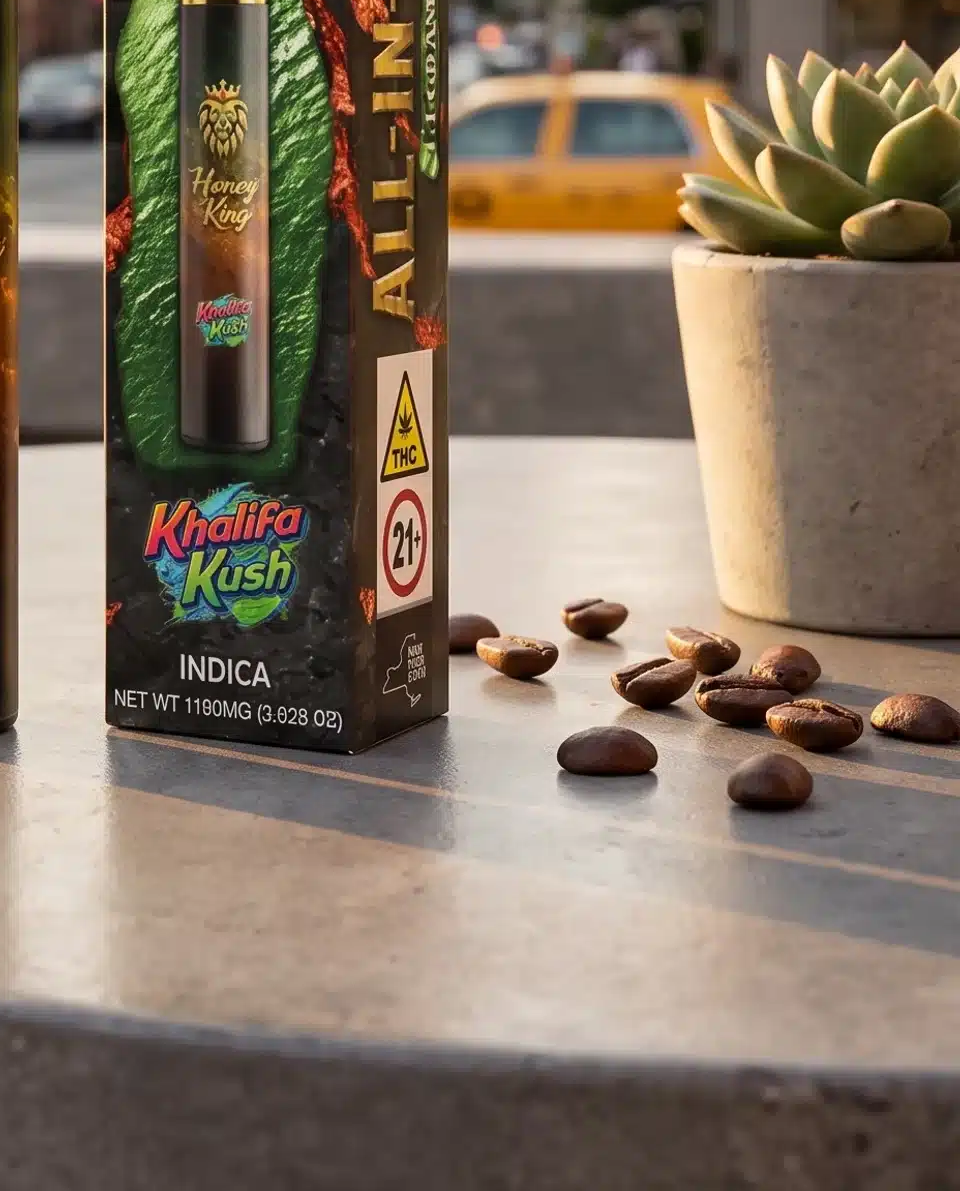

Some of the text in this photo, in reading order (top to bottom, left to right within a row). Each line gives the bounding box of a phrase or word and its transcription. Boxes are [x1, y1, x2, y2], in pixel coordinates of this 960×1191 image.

[188, 166, 260, 205] Honey
[199, 195, 253, 232] King
[392, 444, 417, 469] THC
[144, 499, 307, 559] Khalifa
[392, 518, 421, 570] 21+
[182, 549, 292, 609] Kush
[179, 653, 272, 688] INDICA
[114, 688, 149, 709] NET
[152, 692, 180, 712] WT
